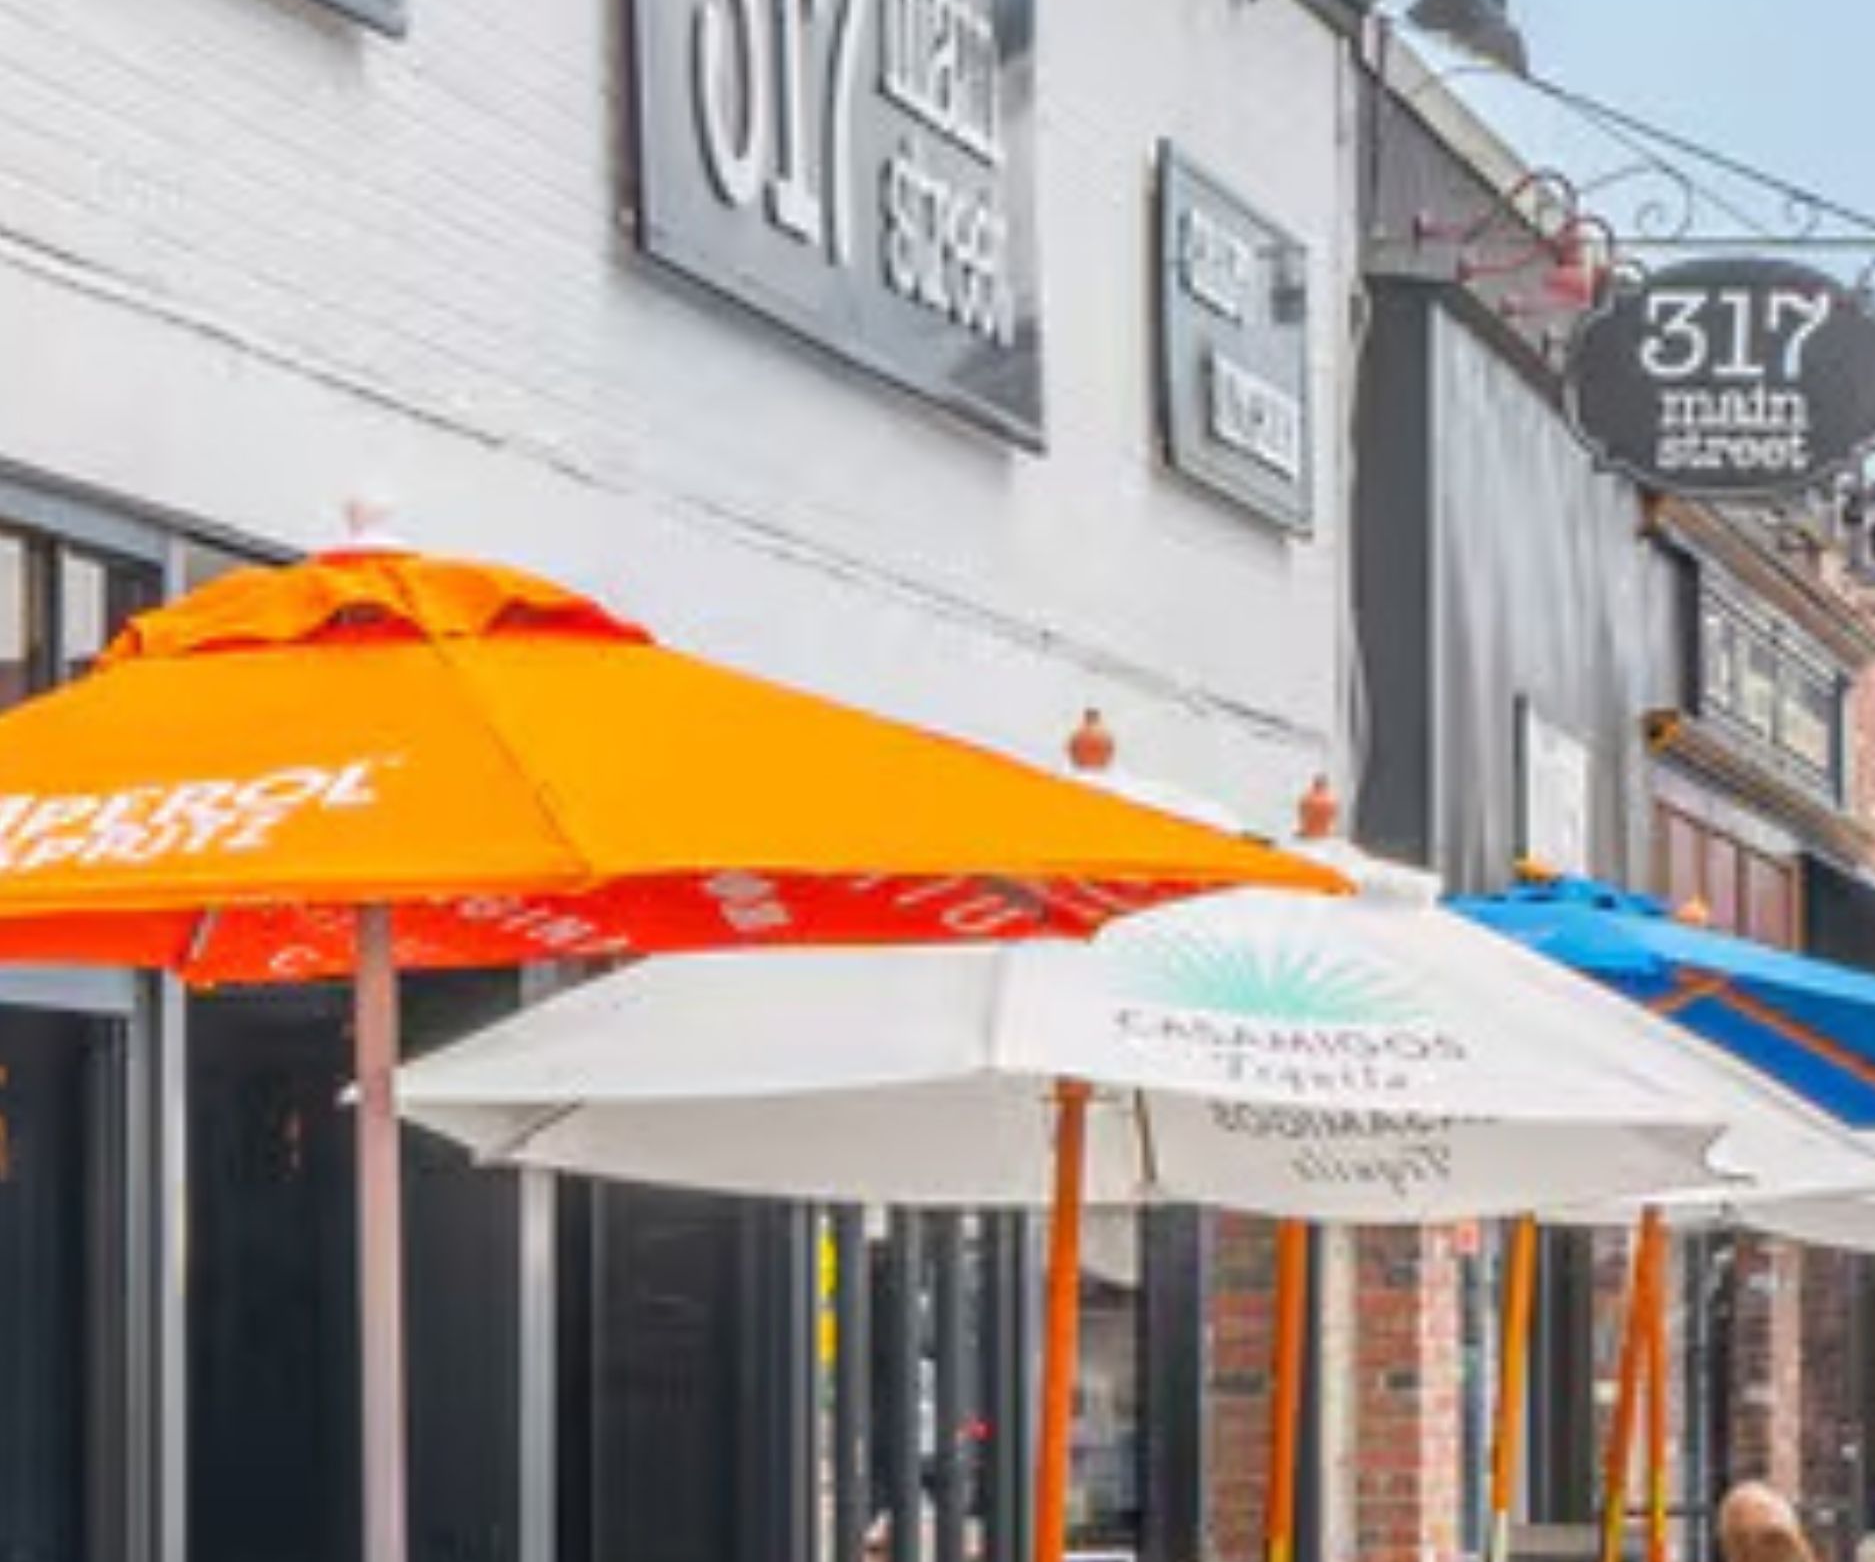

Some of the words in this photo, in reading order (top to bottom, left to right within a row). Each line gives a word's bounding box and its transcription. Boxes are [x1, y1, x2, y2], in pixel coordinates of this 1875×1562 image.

[1640, 289, 1830, 379] 317
[1657, 384, 1810, 433] main
[1655, 434, 1811, 470] street
[1114, 1008, 1467, 1061] CASAMIGOS
[1212, 1050, 1408, 1091] Tequila
